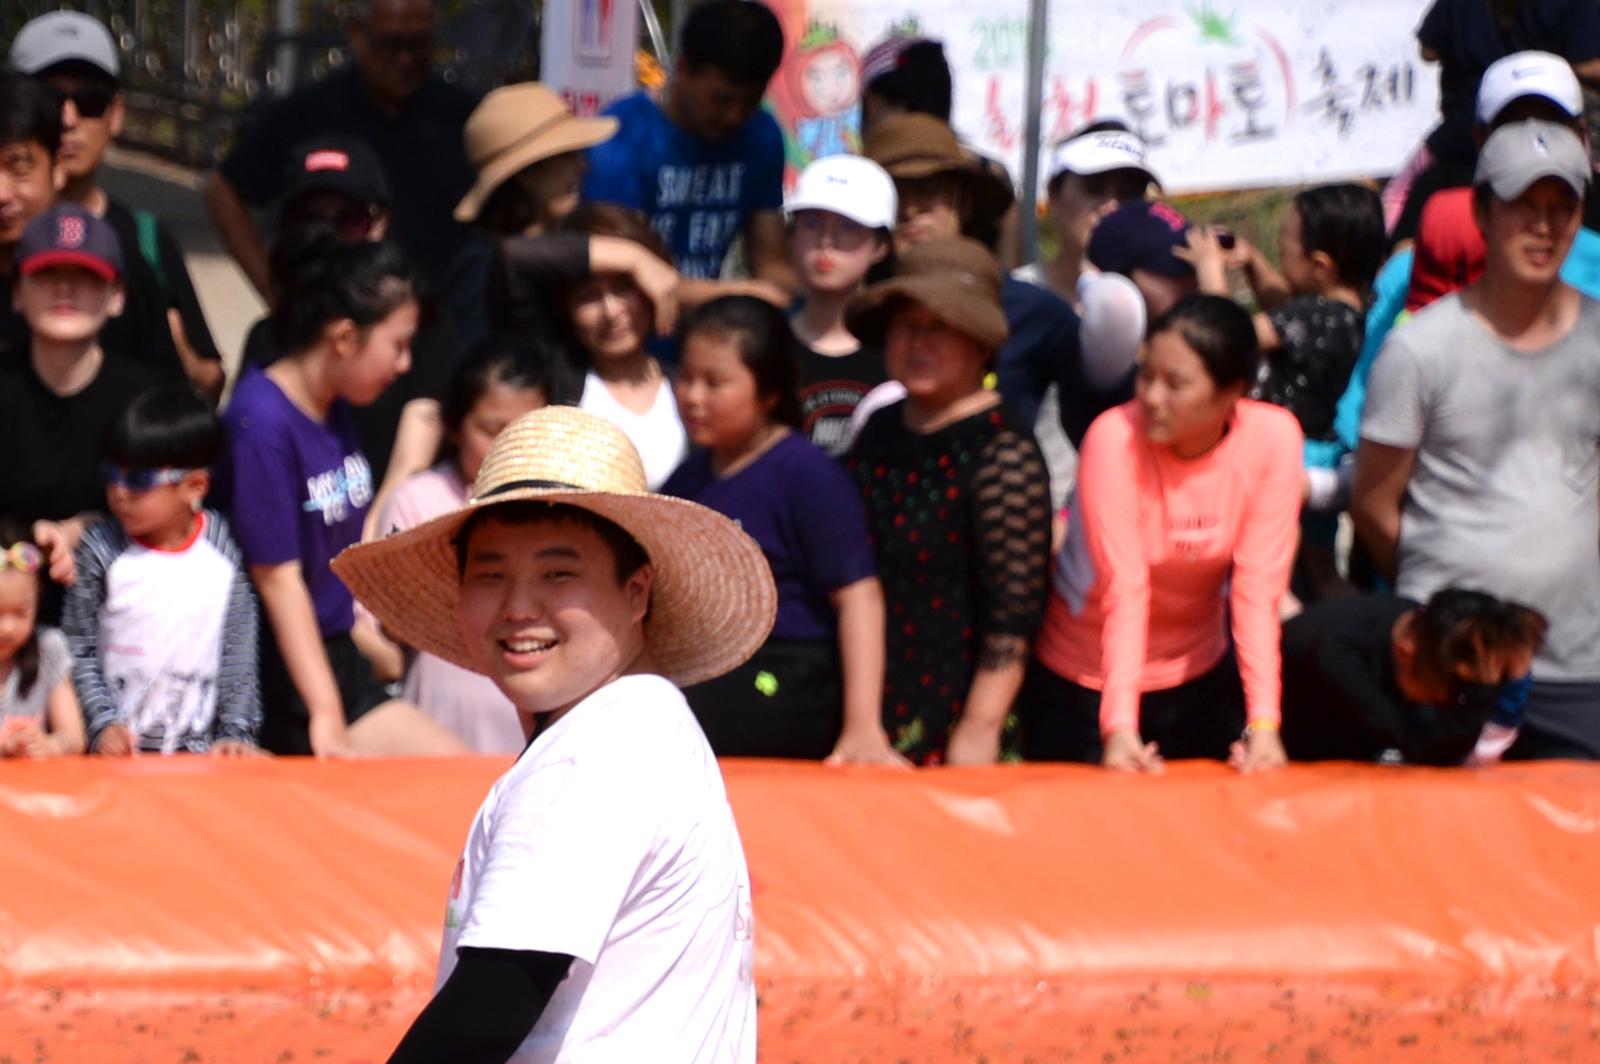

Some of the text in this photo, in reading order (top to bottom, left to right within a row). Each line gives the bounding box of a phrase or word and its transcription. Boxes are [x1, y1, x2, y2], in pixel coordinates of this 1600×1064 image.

[1119, 60, 1277, 147] 토마토
[1301, 46, 1414, 137] 축제
[656, 163, 745, 208] SWEAT
